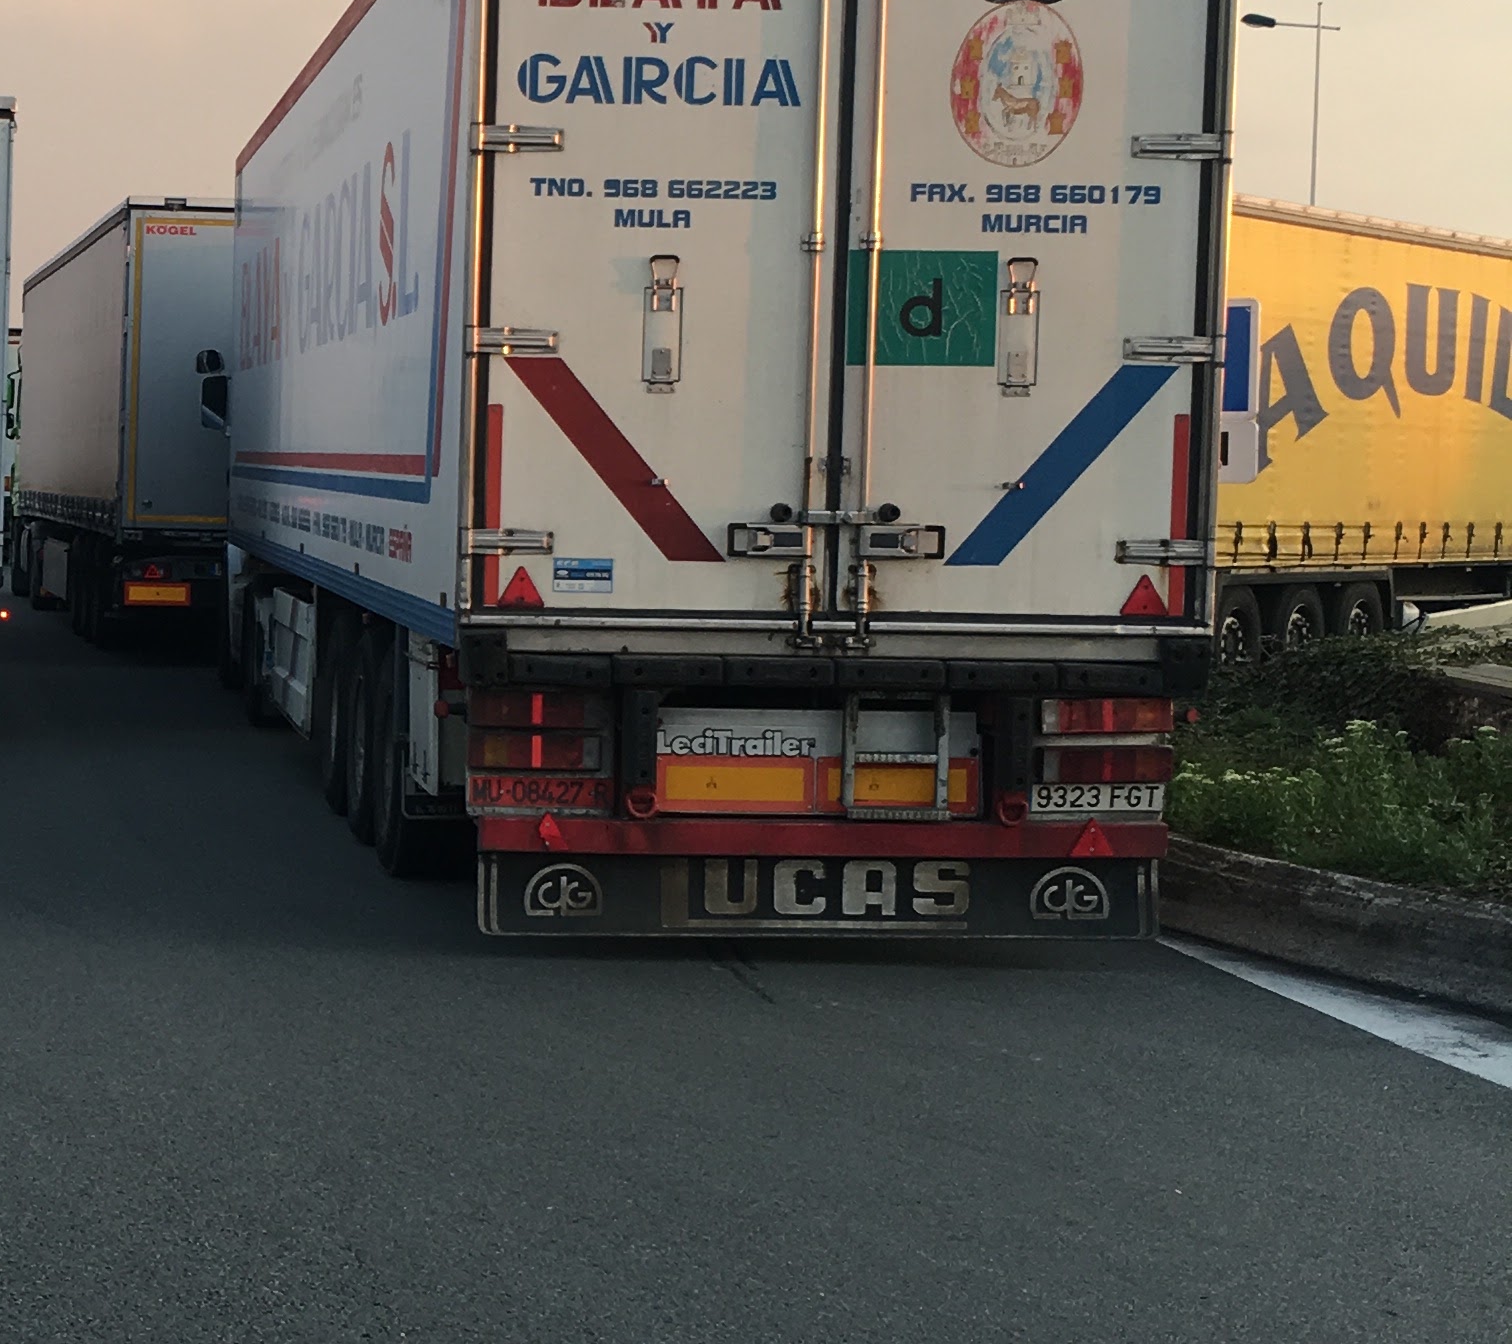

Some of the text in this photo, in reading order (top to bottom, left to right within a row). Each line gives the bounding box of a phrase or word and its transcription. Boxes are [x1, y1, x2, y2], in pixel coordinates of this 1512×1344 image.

[642, 23, 675, 44] Y
[517, 53, 801, 107] GARCIA
[531, 177, 777, 202] TNO. 968 662223
[909, 183, 1161, 206] FAX. 968 660179
[614, 209, 691, 229] MULA
[981, 214, 1088, 234] MURCIA
[656, 729, 815, 757] LeciTrailer
[1037, 785, 1160, 809] 9323 FGT
[704, 859, 970, 916] UCAS
